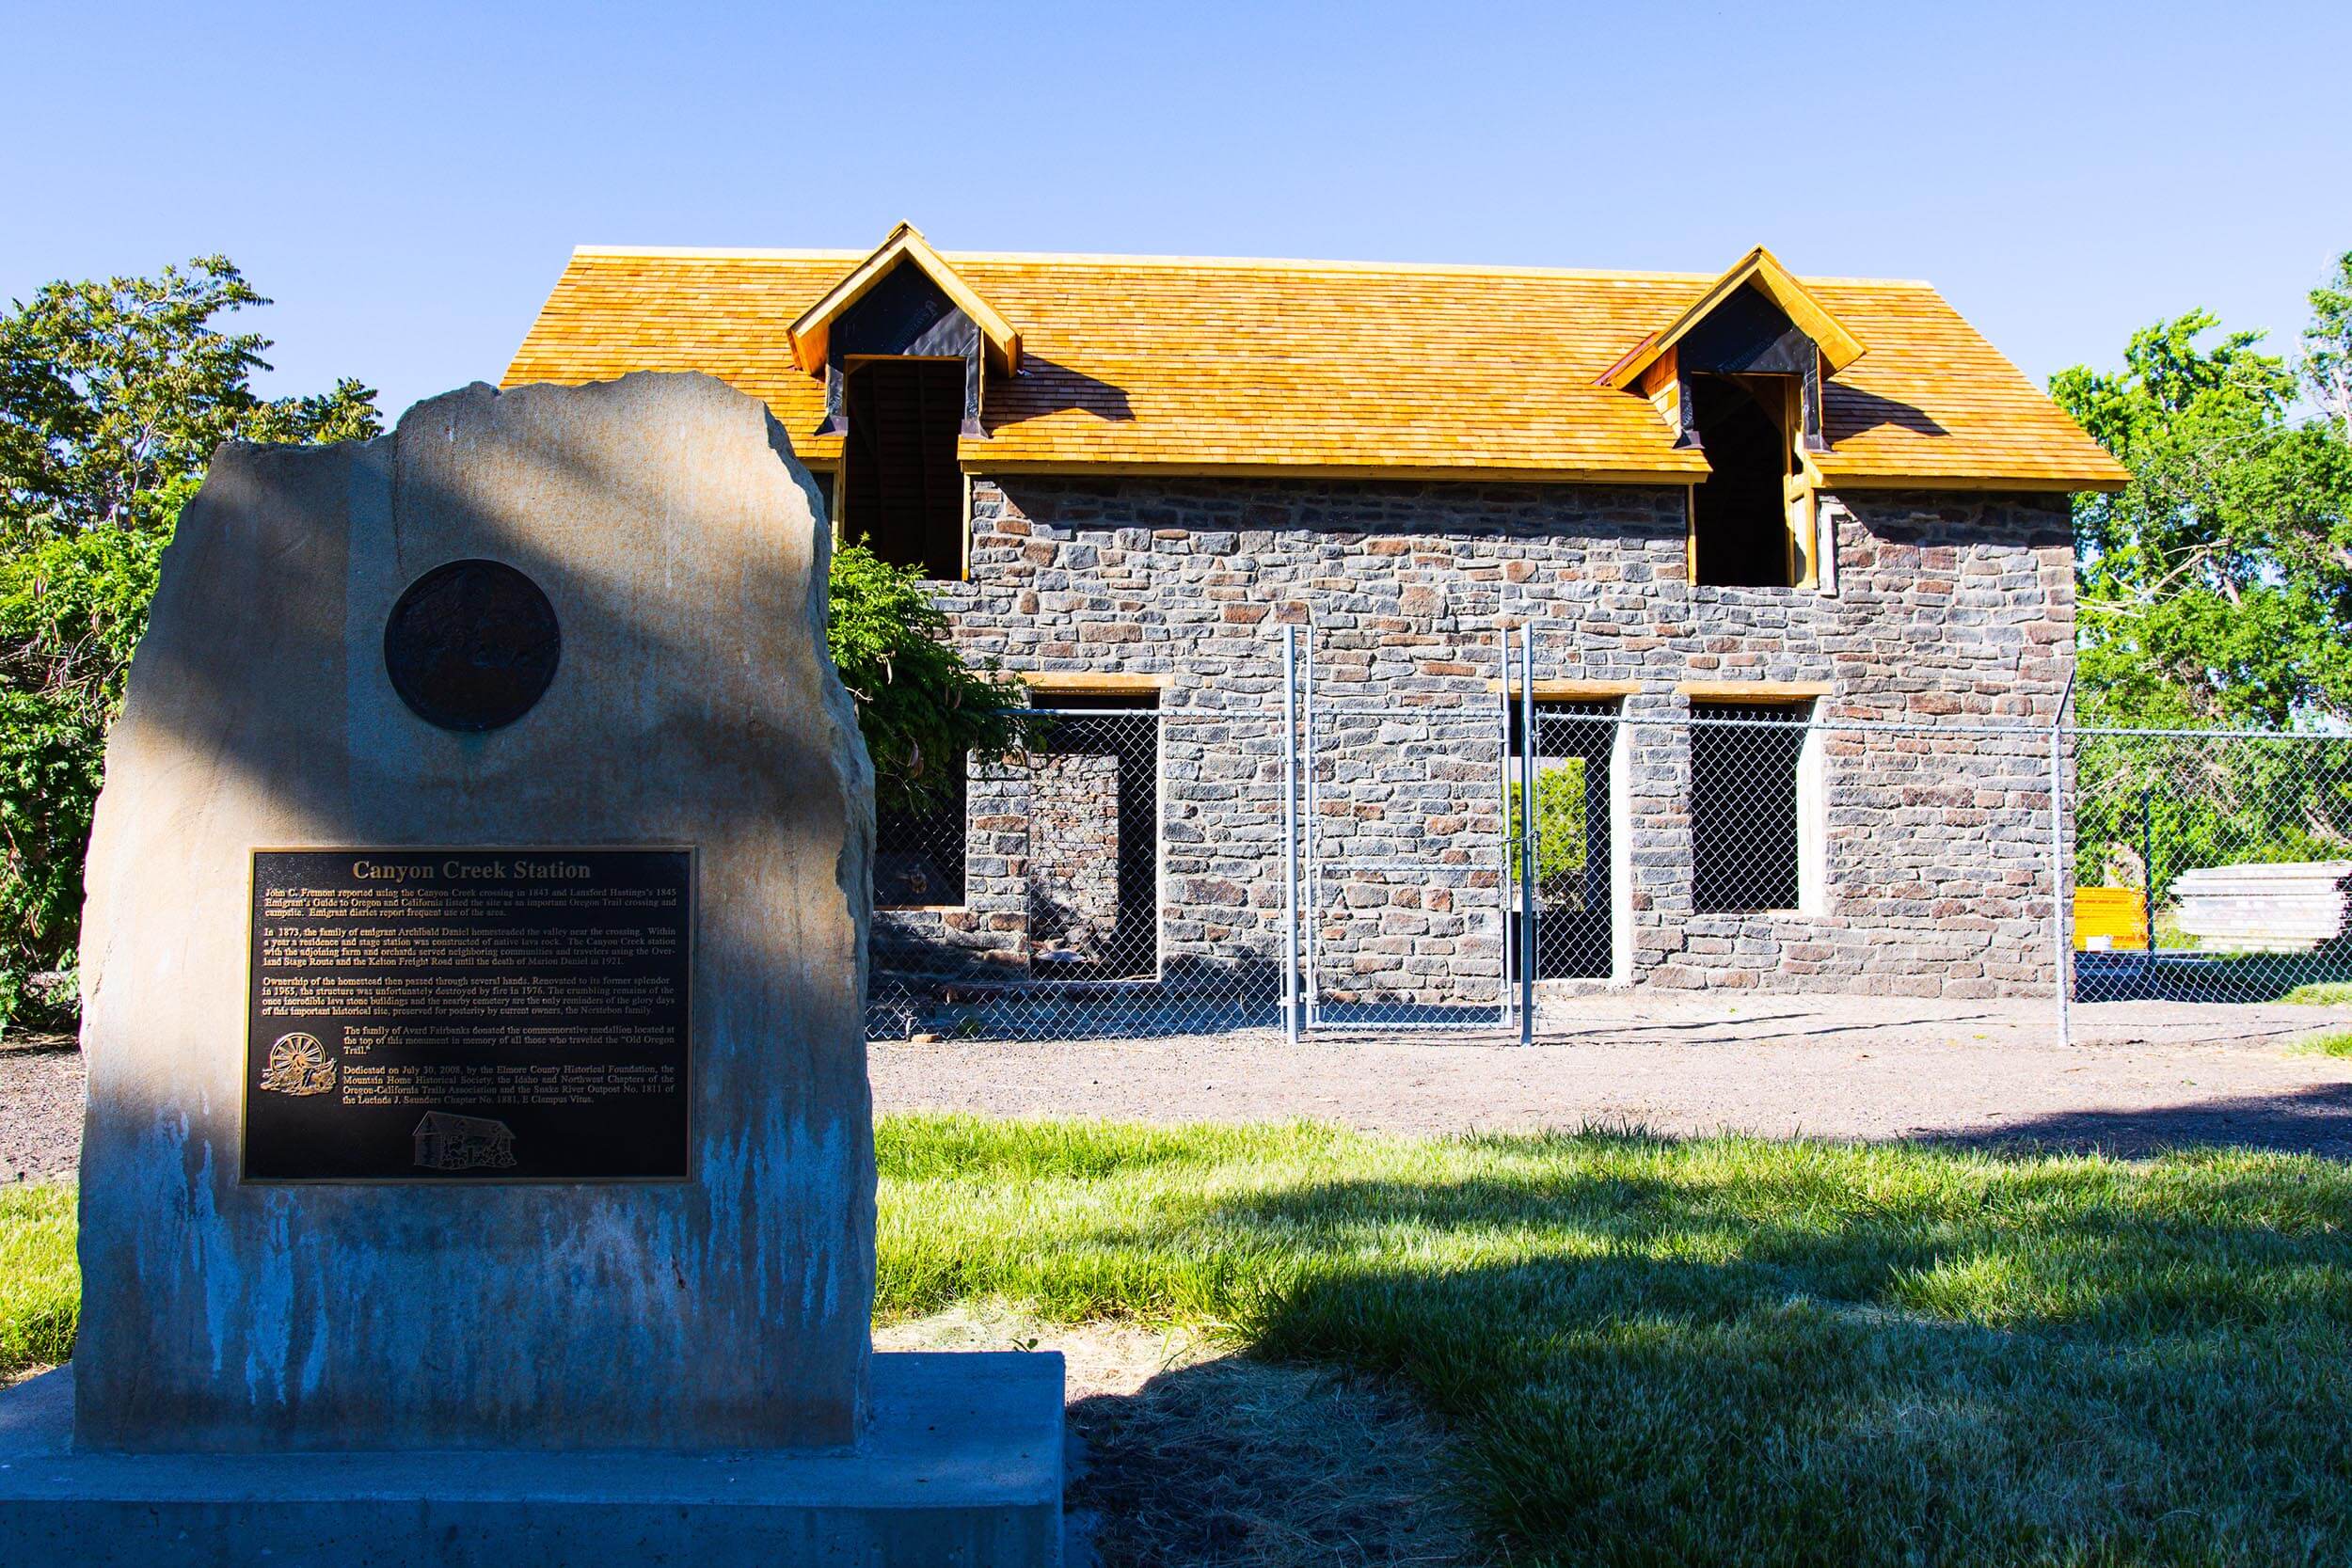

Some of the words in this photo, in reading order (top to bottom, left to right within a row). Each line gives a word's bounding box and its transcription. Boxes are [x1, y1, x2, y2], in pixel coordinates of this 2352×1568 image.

[352, 862, 434, 883] Canyon
[443, 862, 506, 879] Creek
[514, 862, 592, 878] Station
[265, 888, 285, 897] John
[300, 888, 335, 897] Fremont
[338, 888, 373, 899] reported
[376, 888, 399, 899] using
[264, 898, 310, 909] Emigrant's
[312, 898, 338, 907] Guide
[351, 898, 382, 909] Oregon
[383, 898, 399, 907] and
[401, 898, 443, 907] California
[264, 908, 304, 919] campsite.
[308, 908, 348, 919] Emigrant
[349, 908, 378, 917] diaries
[380, 908, 405, 919] report
[407, 908, 442, 919] frequent
[279, 928, 302, 938] 1873,
[303, 928, 317, 936] the
[319, 928, 346, 939] family
[360, 928, 396, 939] emigrant
[398, 927, 439, 936] Archibald
[442, 927, 469, 936] Daniel
[271, 940, 290, 949] year
[299, 937, 339, 946] residence
[341, 937, 357, 946] and
[359, 937, 380, 948] stage
[383, 937, 411, 946] station
[263, 947, 282, 956] with
[284, 947, 298, 956] the
[300, 947, 339, 958] adjoining
[341, 947, 361, 956] farm
[363, 947, 379, 956] and
[381, 947, 416, 956] orchards
[419, 947, 446, 956] served
[263, 957, 282, 966] land
[283, 957, 307, 968] Stage
[309, 957, 334, 966] Route
[335, 957, 351, 966] and
[353, 957, 367, 966] the
[368, 957, 397, 965] Kelton
[399, 957, 429, 968] Freight
[431, 957, 453, 965] Road
[455, 957, 474, 965] until
[263, 977, 309, 988] Ownership
[322, 977, 335, 985] the
[338, 977, 382, 985] homestead
[384, 976, 403, 985] then
[405, 976, 433, 987] passed
[435, 976, 468, 987] through
[274, 987, 297, 996] 1965,
[299, 987, 313, 995] the
[316, 986, 354, 995] structure
[376, 986, 433, 997] unfortunately
[283, 997, 325, 1005] incredible
[327, 996, 344, 1005] lava
[346, 996, 368, 1005] stone
[370, 996, 408, 1007] buildings
[273, 1007, 288, 1016] this
[290, 1007, 330, 1018] important
[332, 1007, 371, 1015] historical
[344, 1026, 360, 1035] The
[363, 1026, 390, 1037] family
[344, 1036, 357, 1045] the
[360, 1036, 373, 1047] top
[387, 1036, 403, 1044] this
[343, 1046, 371, 1055] Trail."
[343, 1065, 385, 1074] Dedicated
[403, 1065, 420, 1076] July
[343, 1075, 383, 1084] Mountain
[387, 1075, 412, 1084] Home
[343, 1086, 418, 1097] Oregon-California
[342, 1096, 356, 1104] the
[358, 1096, 392, 1104] Lucinda
[403, 1095, 441, 1104] Saunders
